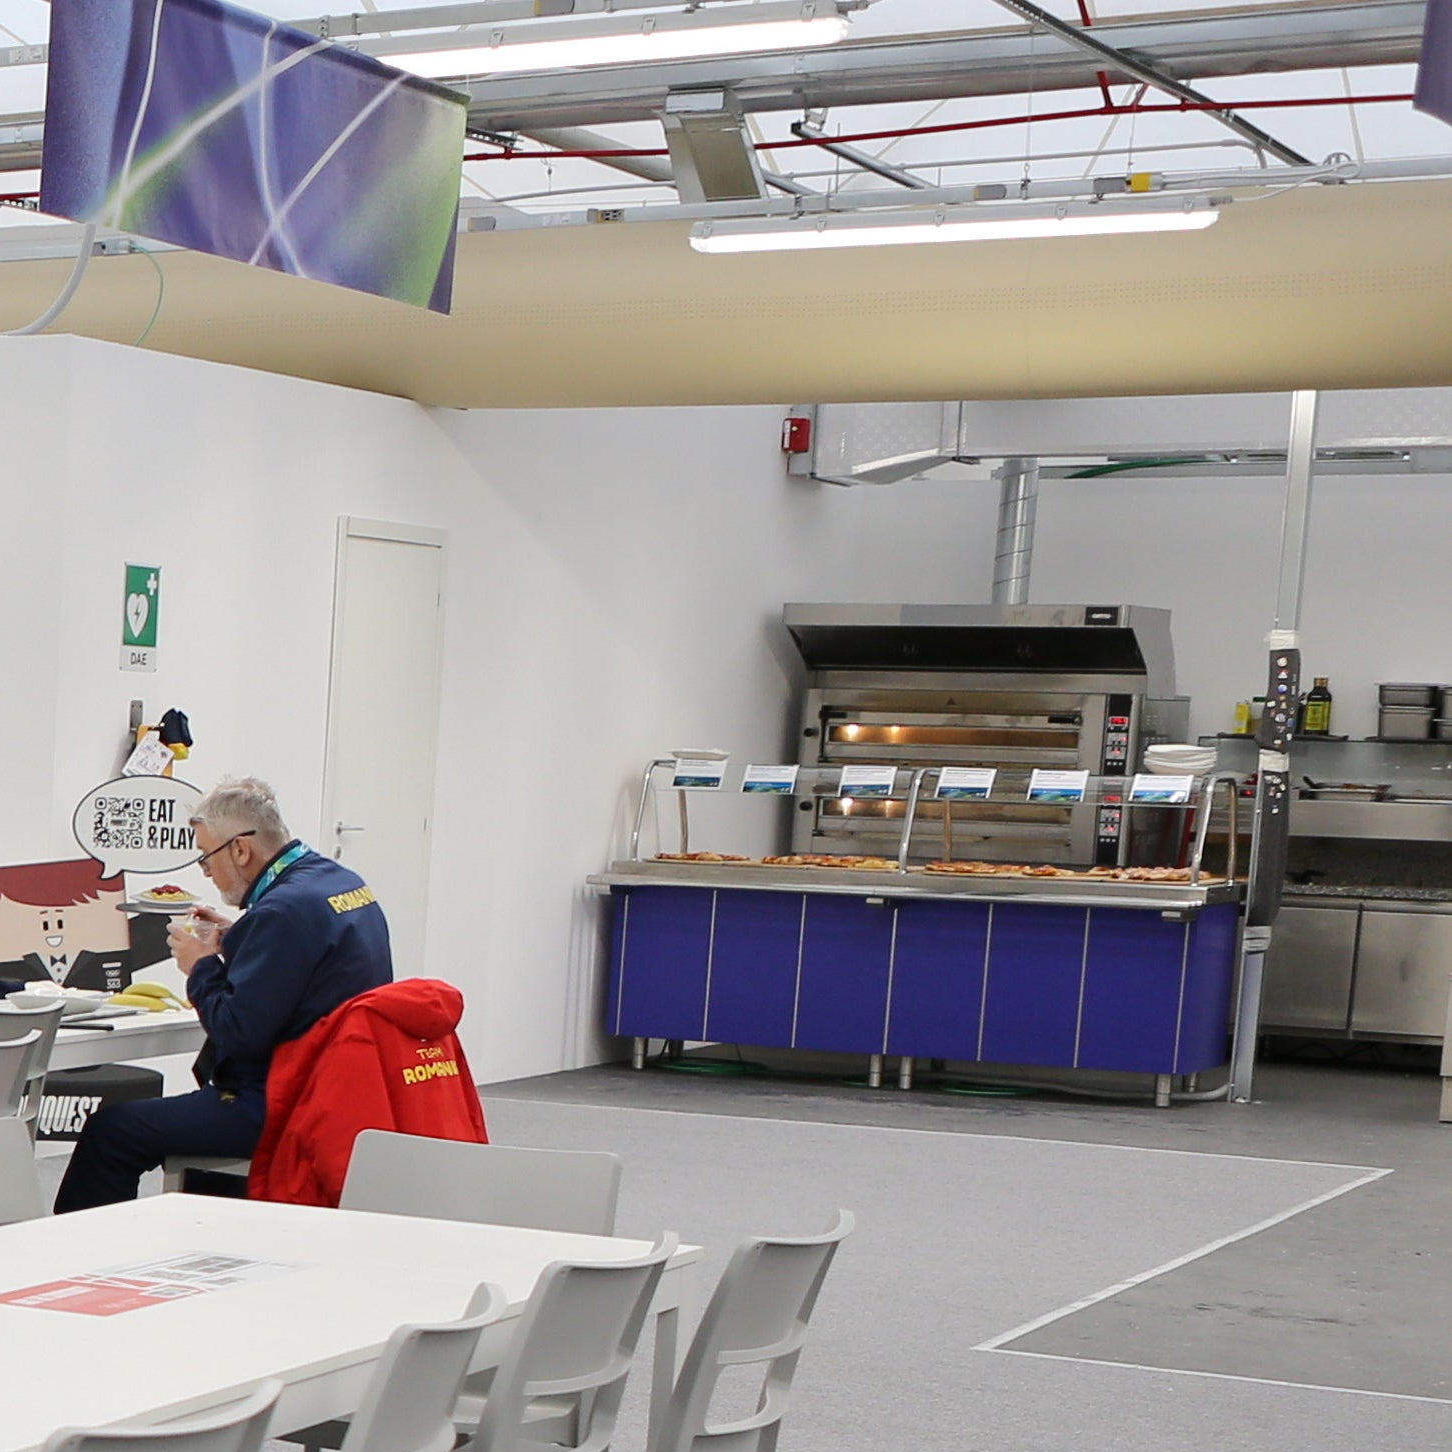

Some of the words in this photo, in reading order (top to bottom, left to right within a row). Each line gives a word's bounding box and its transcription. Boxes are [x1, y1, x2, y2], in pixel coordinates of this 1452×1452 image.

[130, 652, 148, 666] DAE
[148, 799, 176, 823] EAT
[416, 1047, 444, 1059] TEAM
